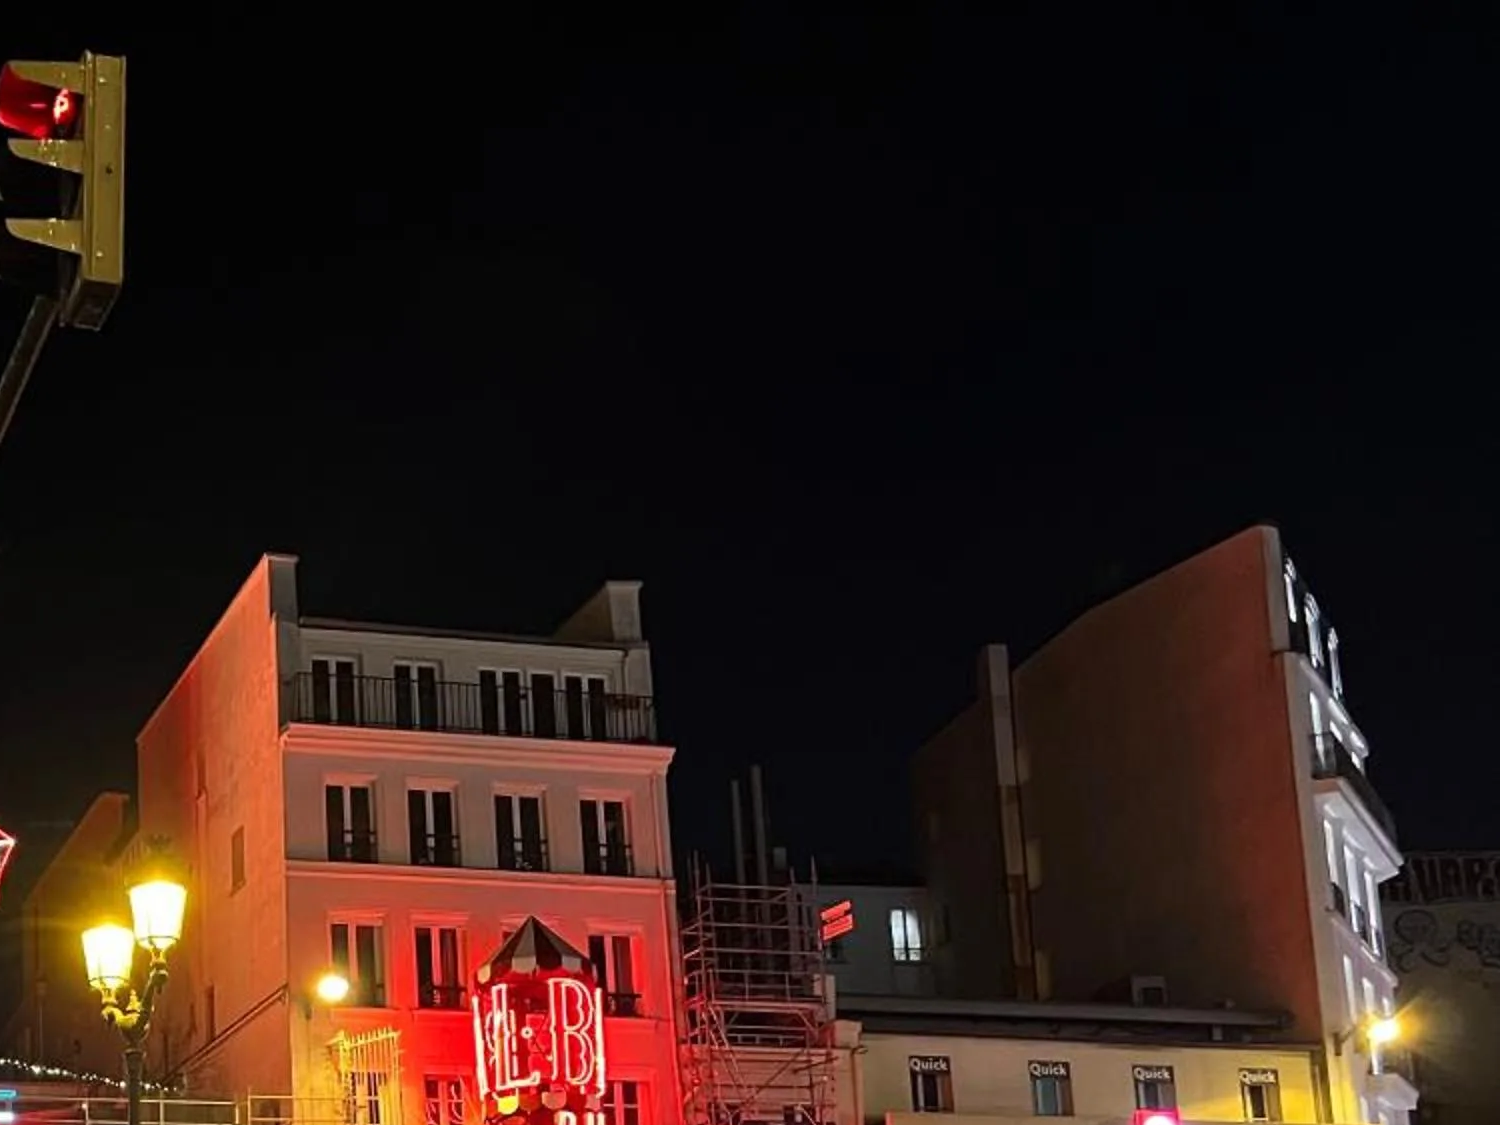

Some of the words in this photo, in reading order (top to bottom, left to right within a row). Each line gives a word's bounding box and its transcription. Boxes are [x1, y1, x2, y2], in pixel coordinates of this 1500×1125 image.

[910, 1057, 949, 1071] Quick
[1029, 1062, 1068, 1077] Quick
[1133, 1065, 1171, 1081] Quick
[1238, 1069, 1277, 1085] Quick
